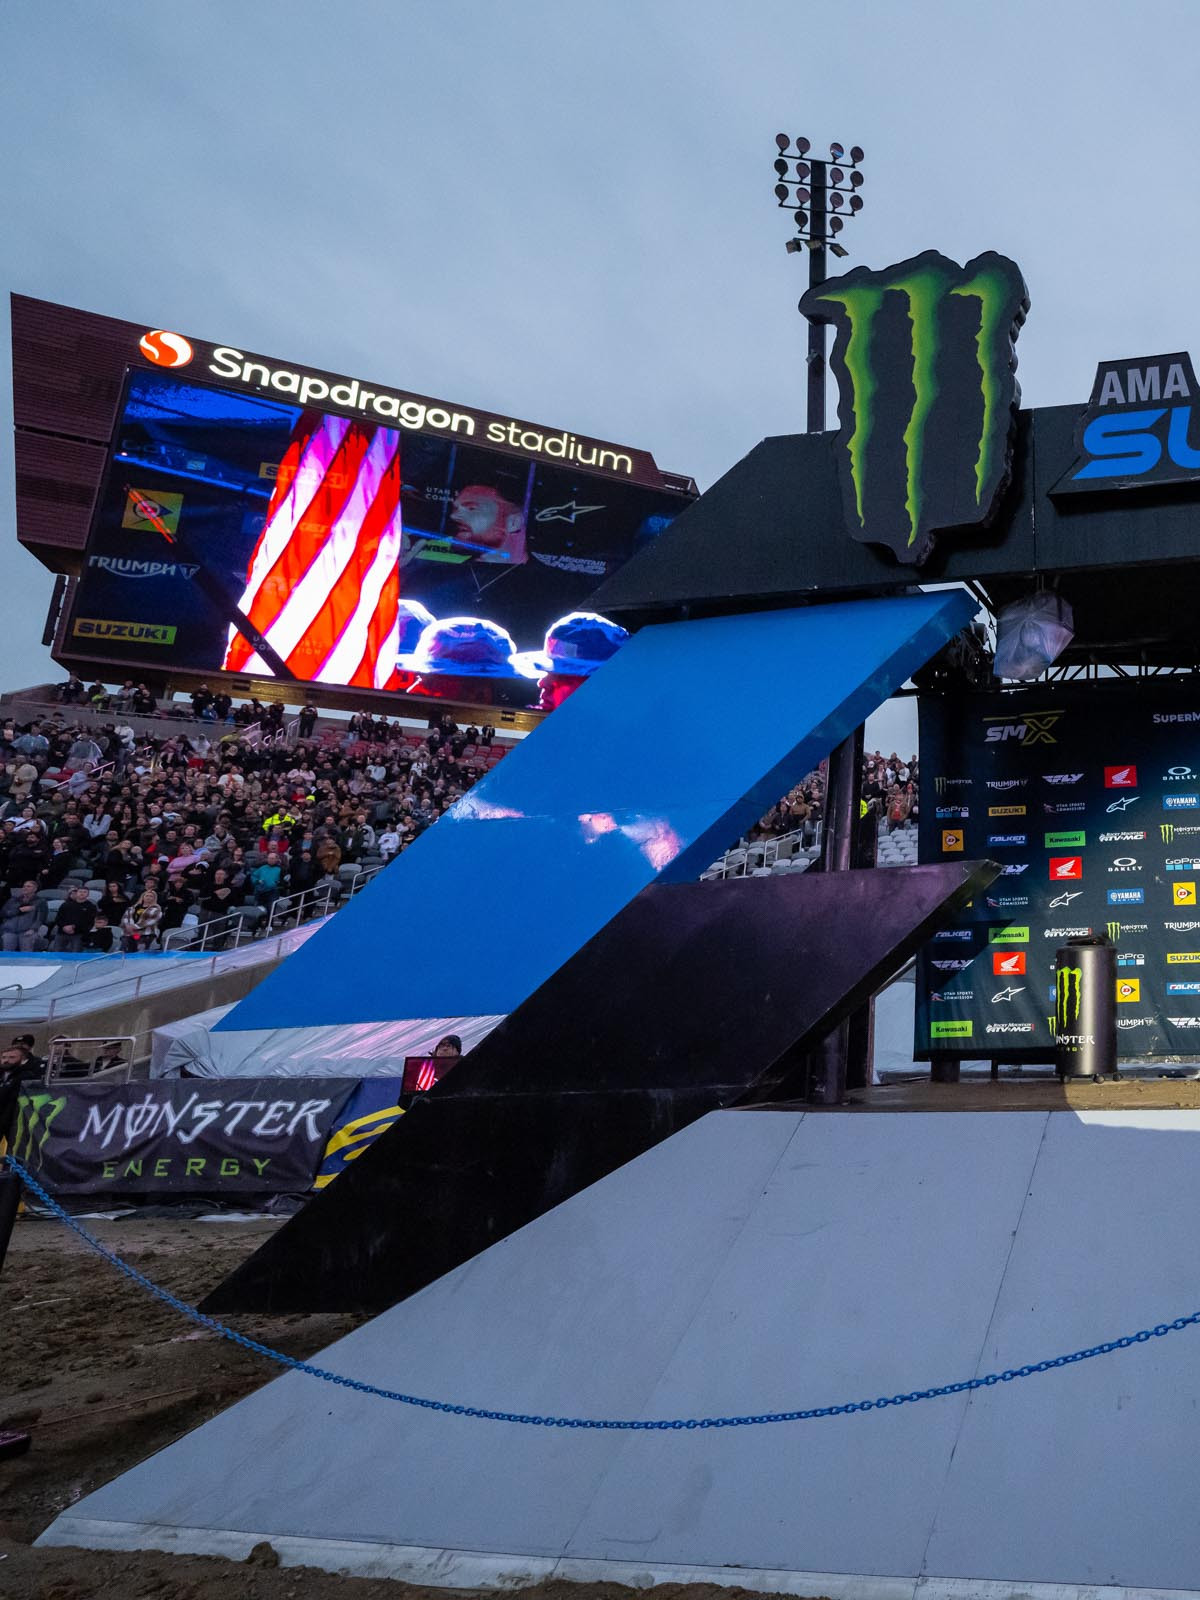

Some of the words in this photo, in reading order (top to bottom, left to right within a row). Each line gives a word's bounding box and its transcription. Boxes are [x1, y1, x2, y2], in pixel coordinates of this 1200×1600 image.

[1099, 361, 1192, 405] AMA
[208, 347, 474, 436] Snapdragon
[486, 421, 632, 474] stadium
[88, 555, 176, 577] TRIUMPH
[77, 621, 169, 640] SUZUKI
[984, 716, 1060, 746] SMX
[985, 780, 1020, 789] TRIUMPH
[936, 806, 969, 814] GoPro
[990, 807, 1024, 815] SUZUKI
[1050, 835, 1080, 844] Kawasaki
[1117, 891, 1142, 899] YAMAHA
[1164, 921, 1200, 931] TRIUMPH
[993, 931, 1025, 940] Kawasaki
[936, 1026, 967, 1034] Kawasaki
[78, 1093, 331, 1150] MONSTER
[101, 1158, 271, 1178] ENERGY
